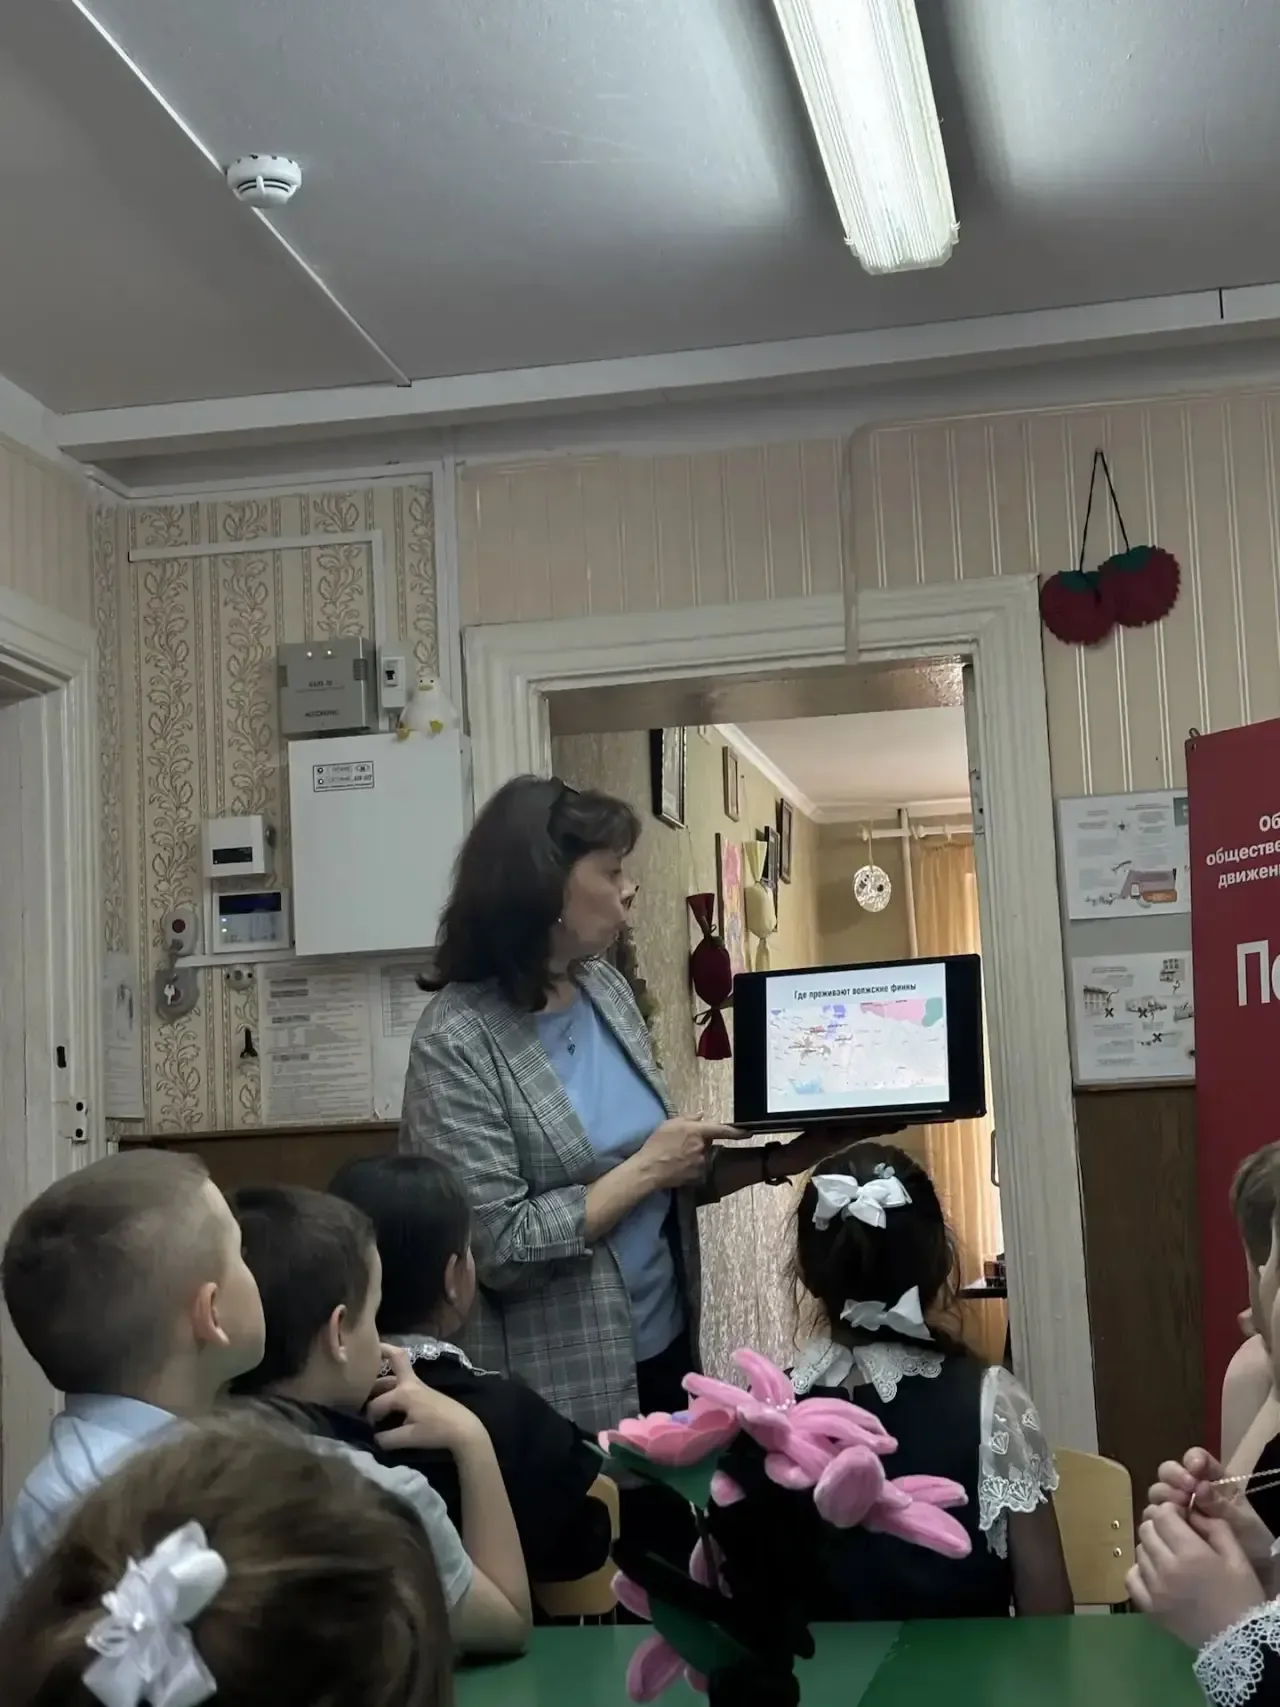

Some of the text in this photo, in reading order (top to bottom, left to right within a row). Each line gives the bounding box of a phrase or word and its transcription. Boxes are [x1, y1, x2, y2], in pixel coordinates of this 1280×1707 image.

[1259, 812, 1280, 832] Об
[1206, 839, 1280, 866] обществе
[1218, 863, 1280, 889] движен
[794, 983, 916, 1000] Где проживают волжские финны
